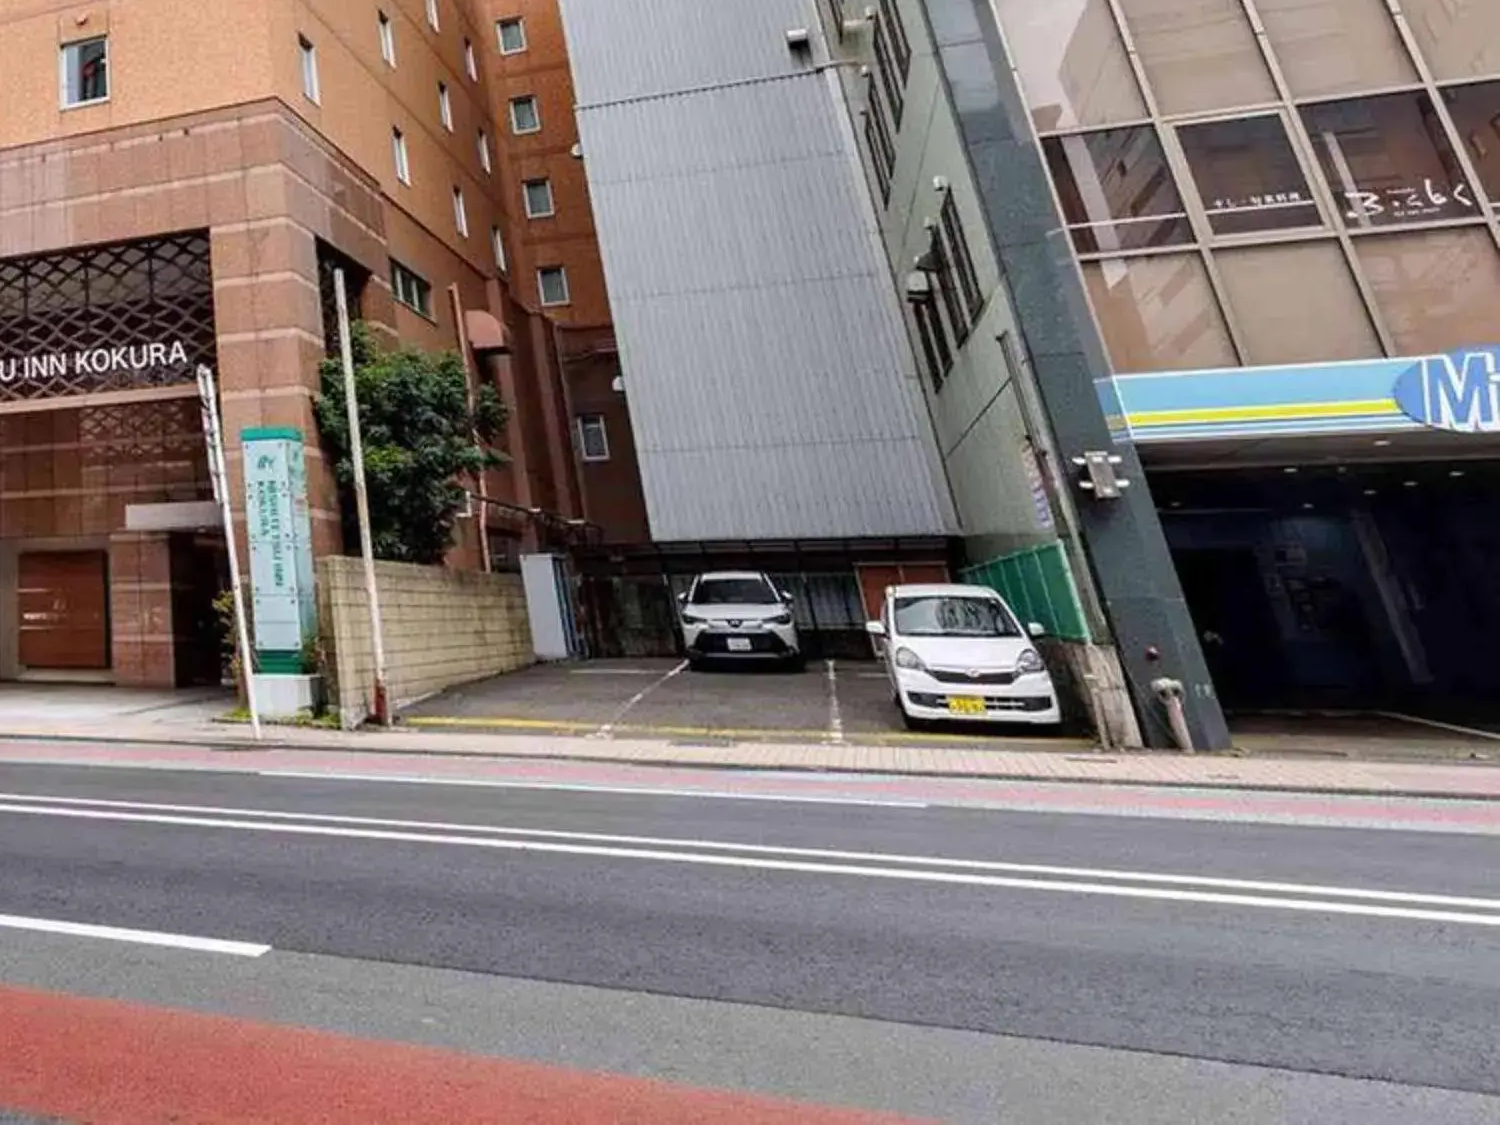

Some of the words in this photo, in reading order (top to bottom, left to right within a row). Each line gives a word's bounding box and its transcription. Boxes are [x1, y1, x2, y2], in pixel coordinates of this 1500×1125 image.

[23, 354, 67, 379] INN
[75, 340, 188, 374] KOKURA
[1421, 352, 1500, 432] M
